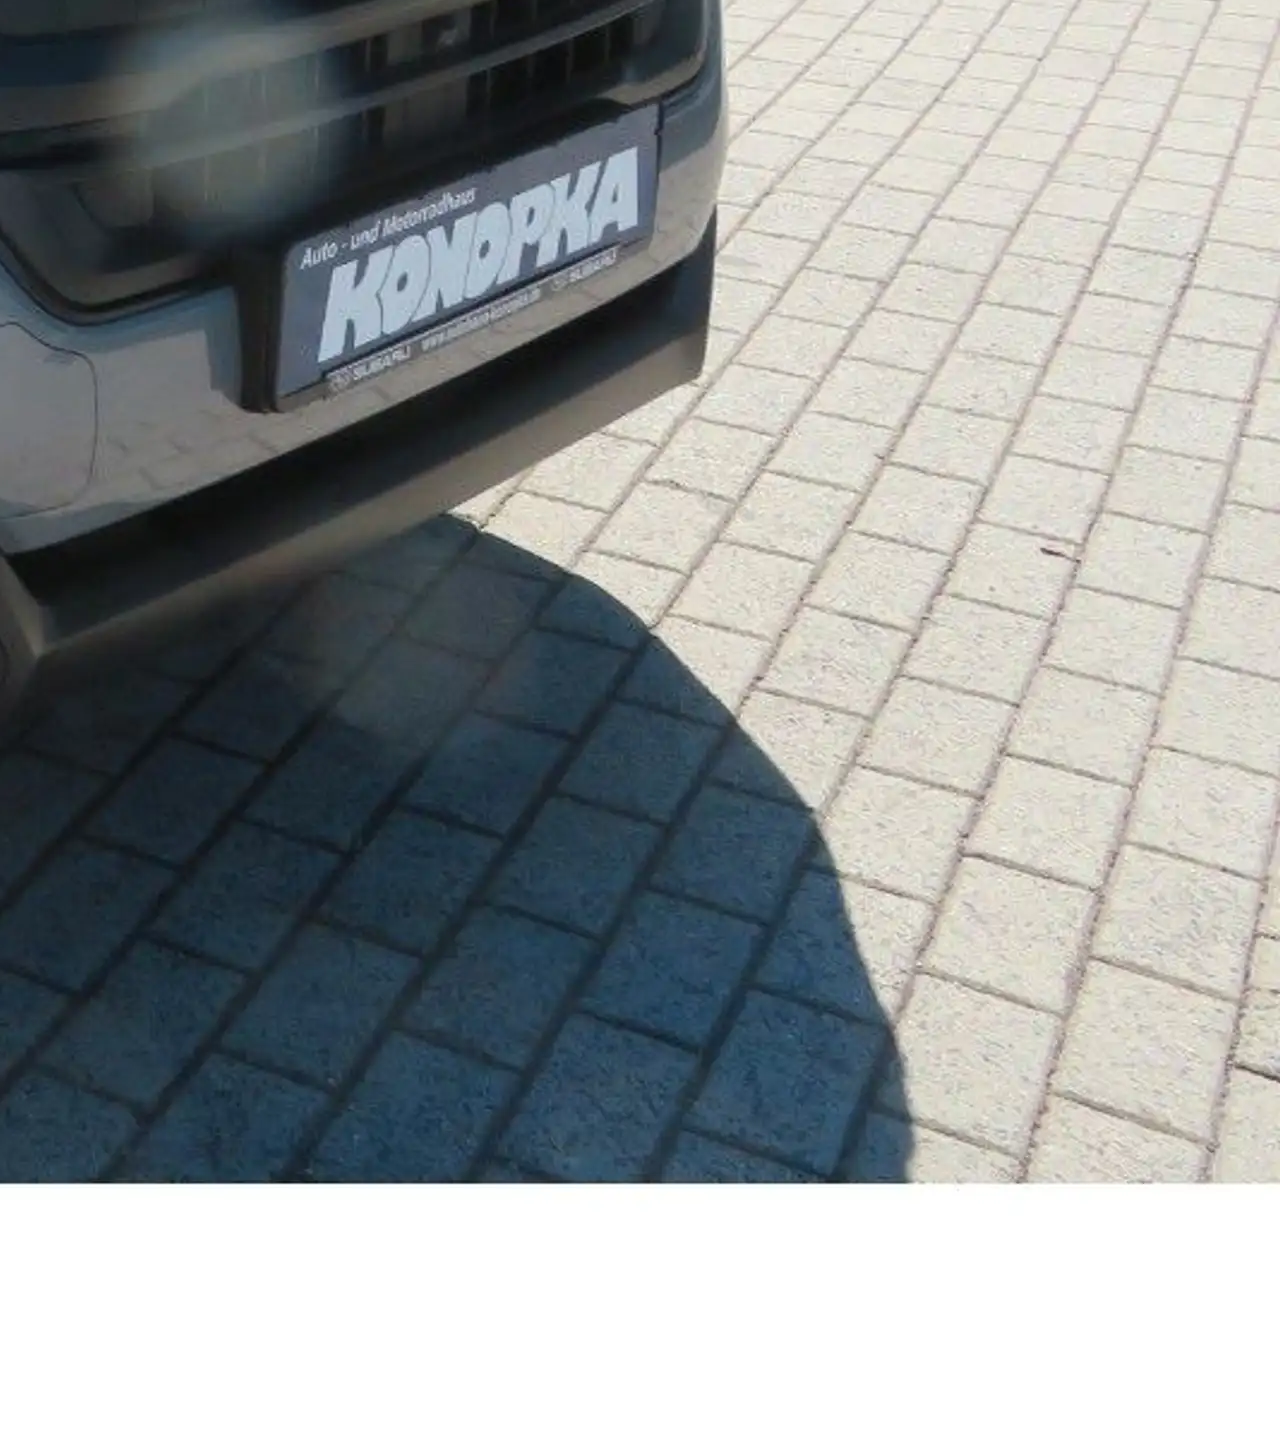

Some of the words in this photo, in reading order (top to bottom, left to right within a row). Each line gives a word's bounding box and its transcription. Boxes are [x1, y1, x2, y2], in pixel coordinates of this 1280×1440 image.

[300, 241, 338, 270] Auto
[350, 220, 382, 250] und
[382, 187, 477, 238] Motorradhaus
[318, 147, 638, 362] KONOPKA
